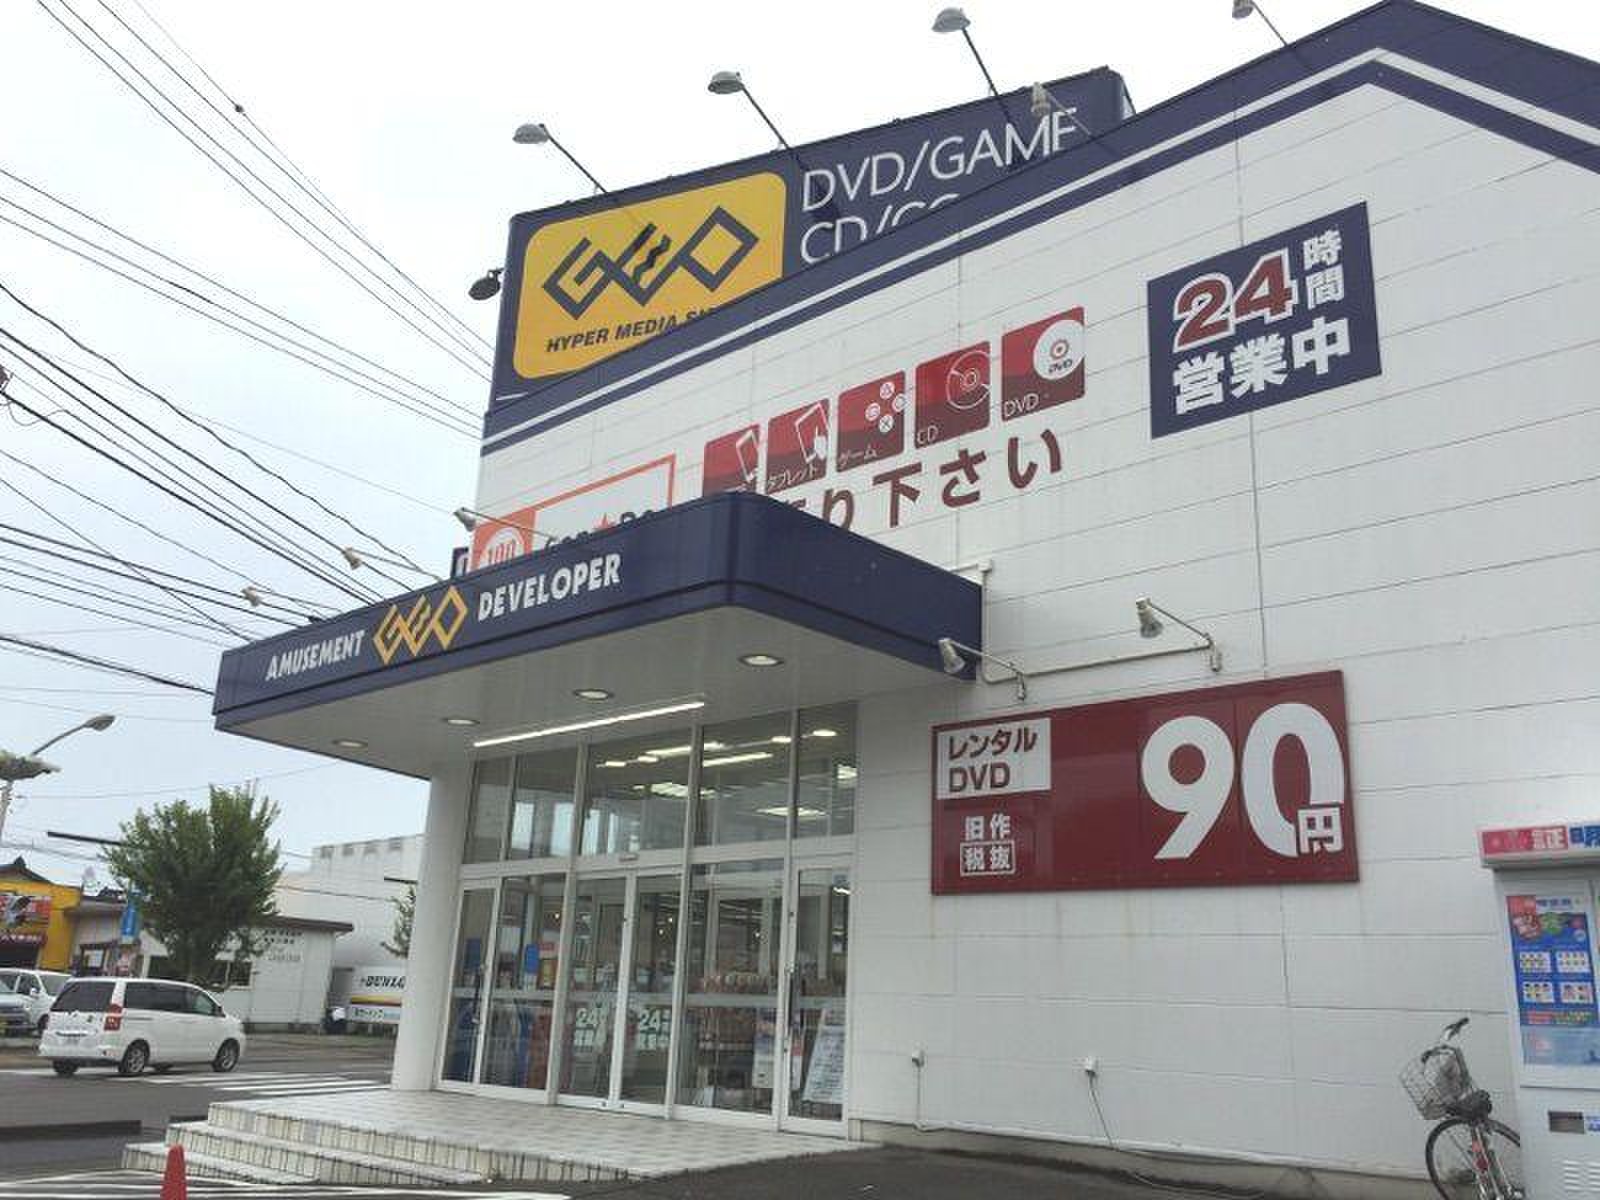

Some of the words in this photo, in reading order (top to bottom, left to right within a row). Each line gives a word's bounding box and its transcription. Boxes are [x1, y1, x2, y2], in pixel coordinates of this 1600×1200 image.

[1172, 247, 1299, 354] 24
[546, 328, 608, 353] HYPER
[615, 314, 677, 340] MEDIA
[1172, 316, 1351, 415] 営業中
[1003, 392, 1039, 418] DVD
[917, 425, 939, 445] CD
[265, 629, 366, 682] AMUSEMENT
[477, 552, 622, 623] DEVELOPER
[948, 727, 1038, 761] レンタル
[949, 761, 1011, 793] DVD
[964, 813, 1012, 841] 旧作
